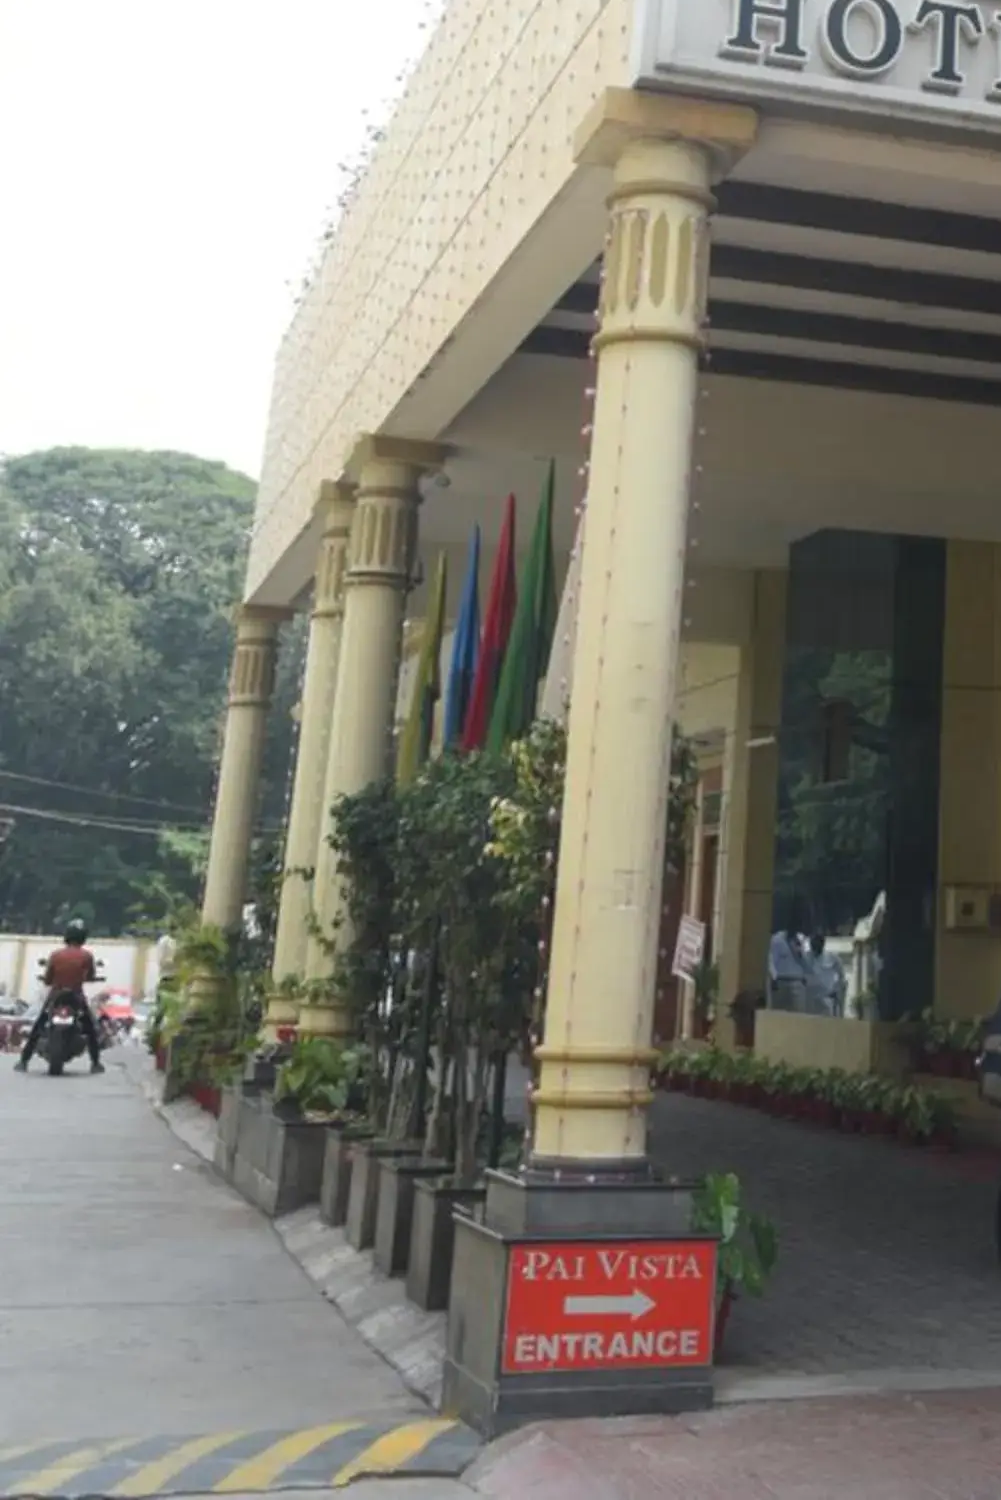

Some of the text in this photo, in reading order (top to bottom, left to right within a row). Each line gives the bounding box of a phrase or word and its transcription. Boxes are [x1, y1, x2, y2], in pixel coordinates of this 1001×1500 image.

[522, 1250, 702, 1280] PAI VISTA
[514, 1330, 700, 1363] ENTRANCE
